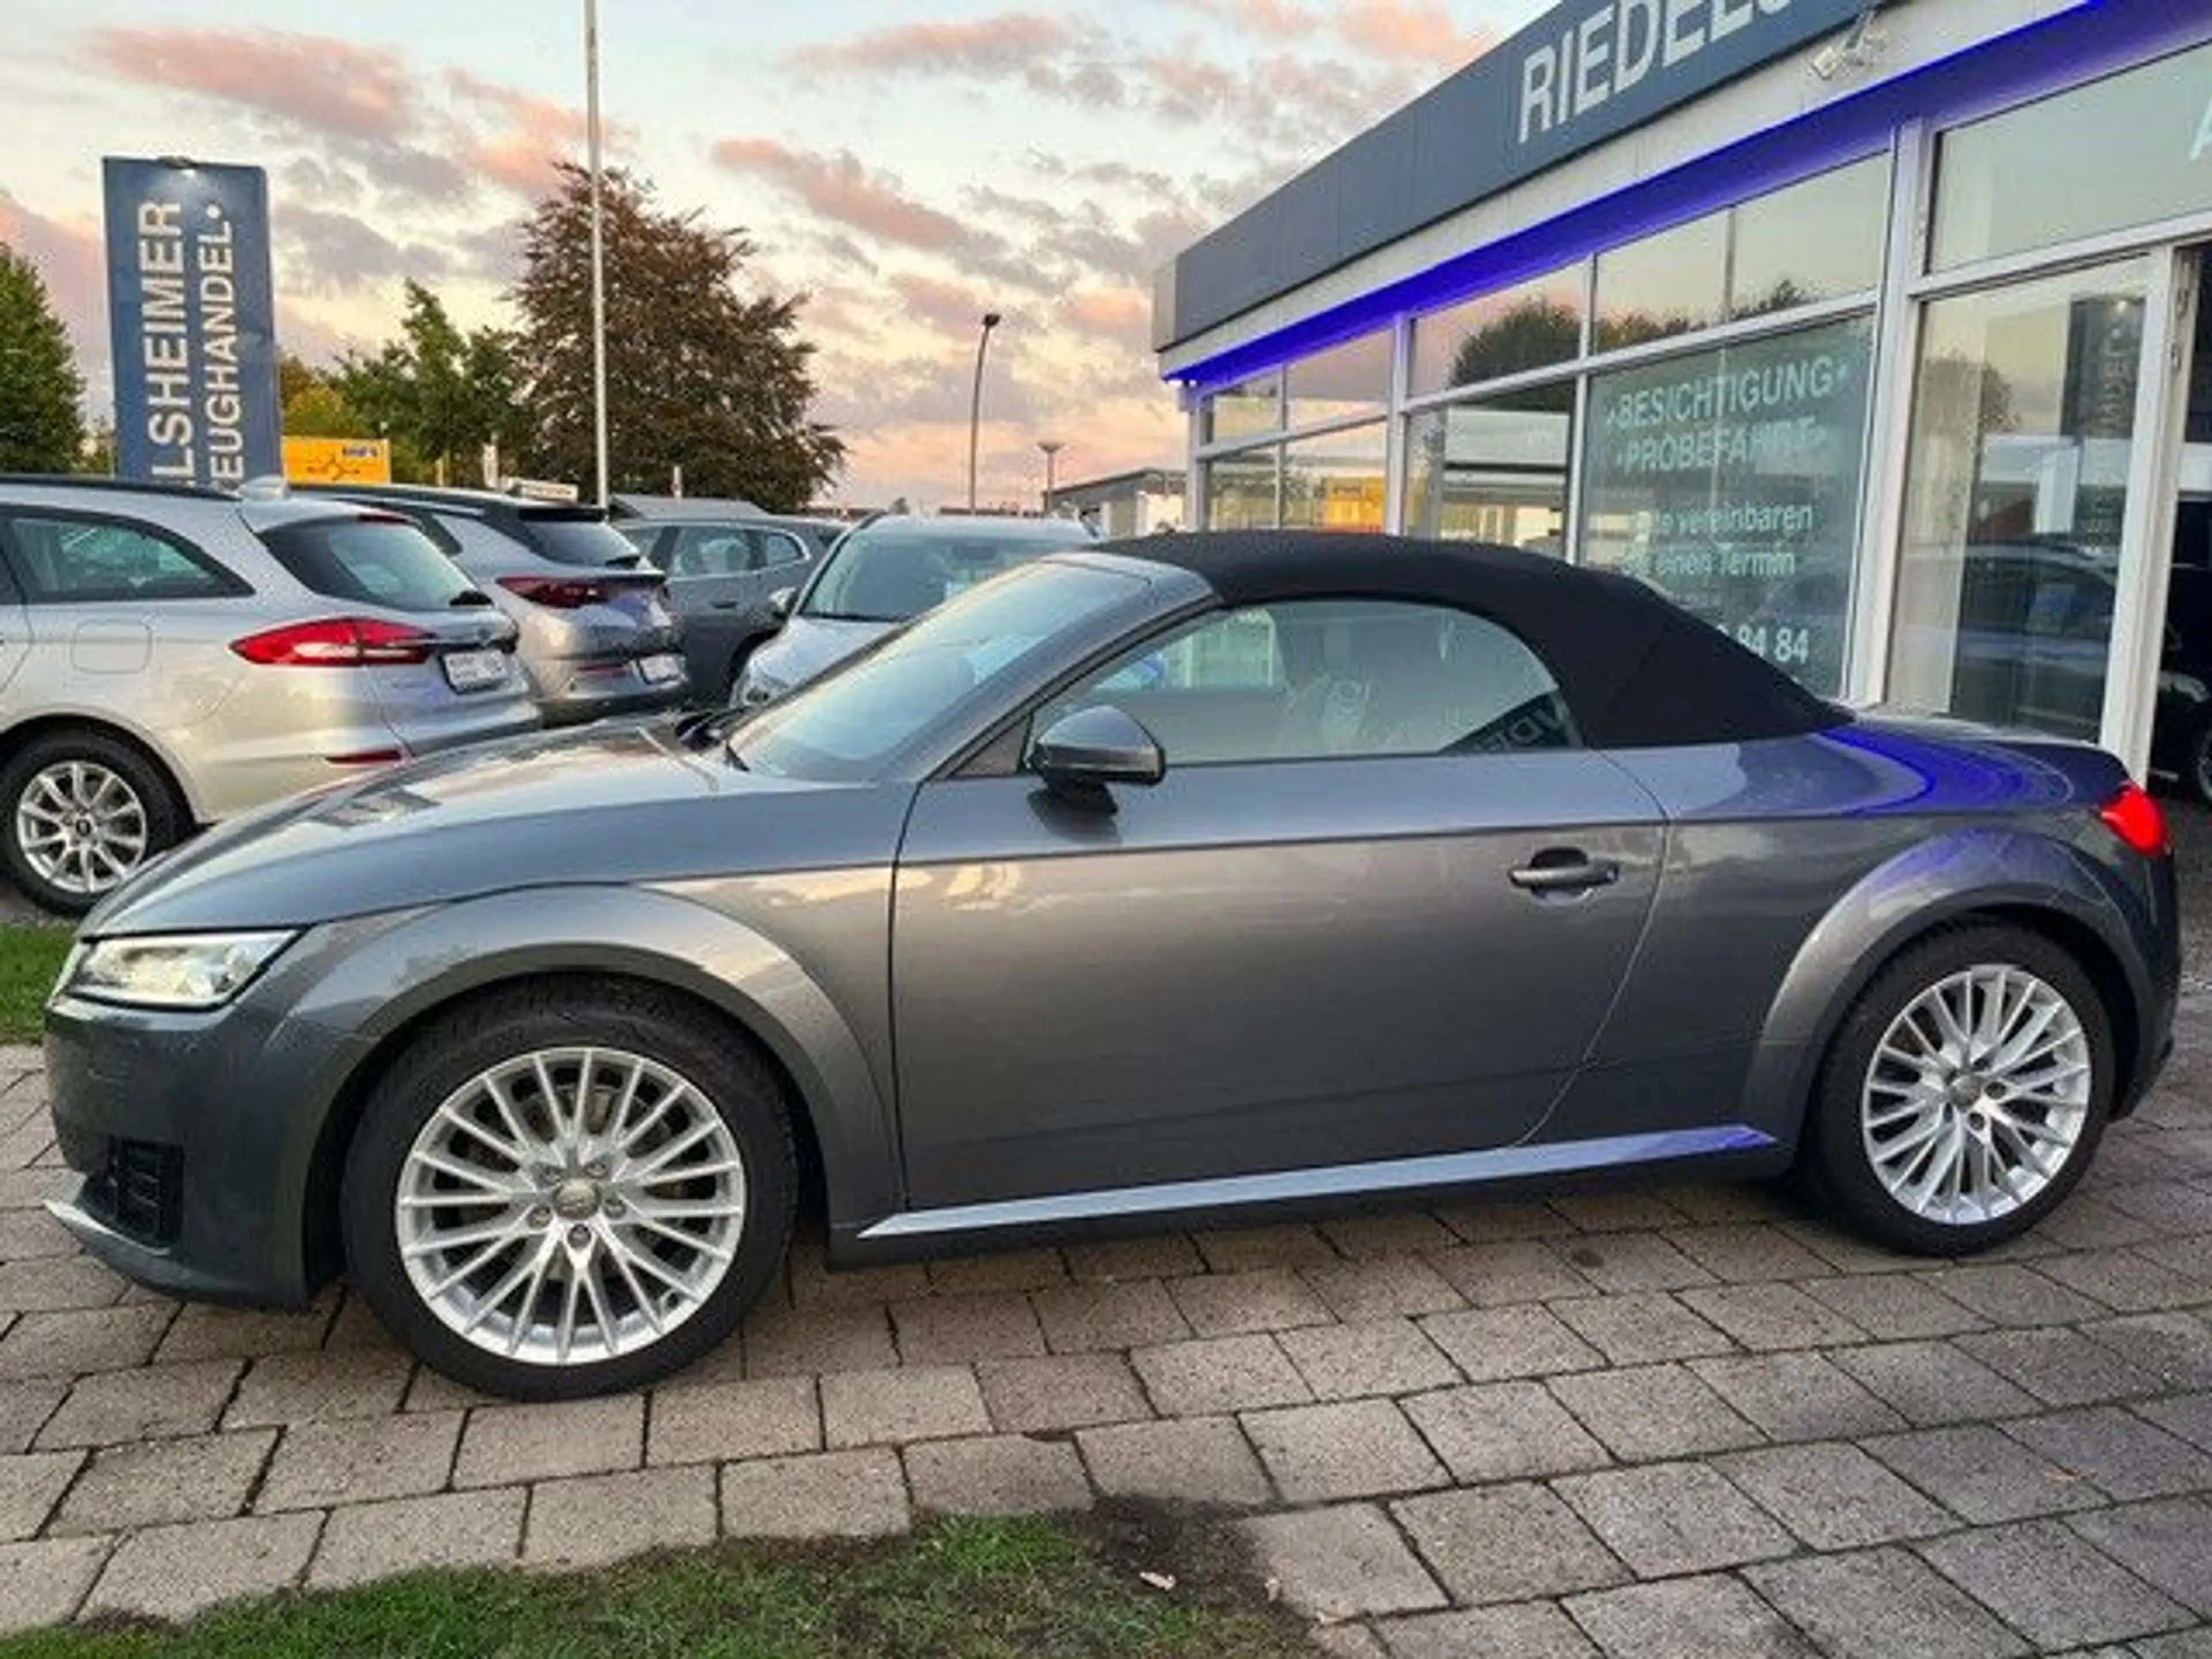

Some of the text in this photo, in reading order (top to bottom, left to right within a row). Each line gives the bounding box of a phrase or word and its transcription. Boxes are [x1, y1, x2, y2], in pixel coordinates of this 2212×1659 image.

[1518, 0, 1791, 144] RIEDEL
[137, 200, 196, 487] LSHEIMER
[1774, 627, 1809, 665] 84
